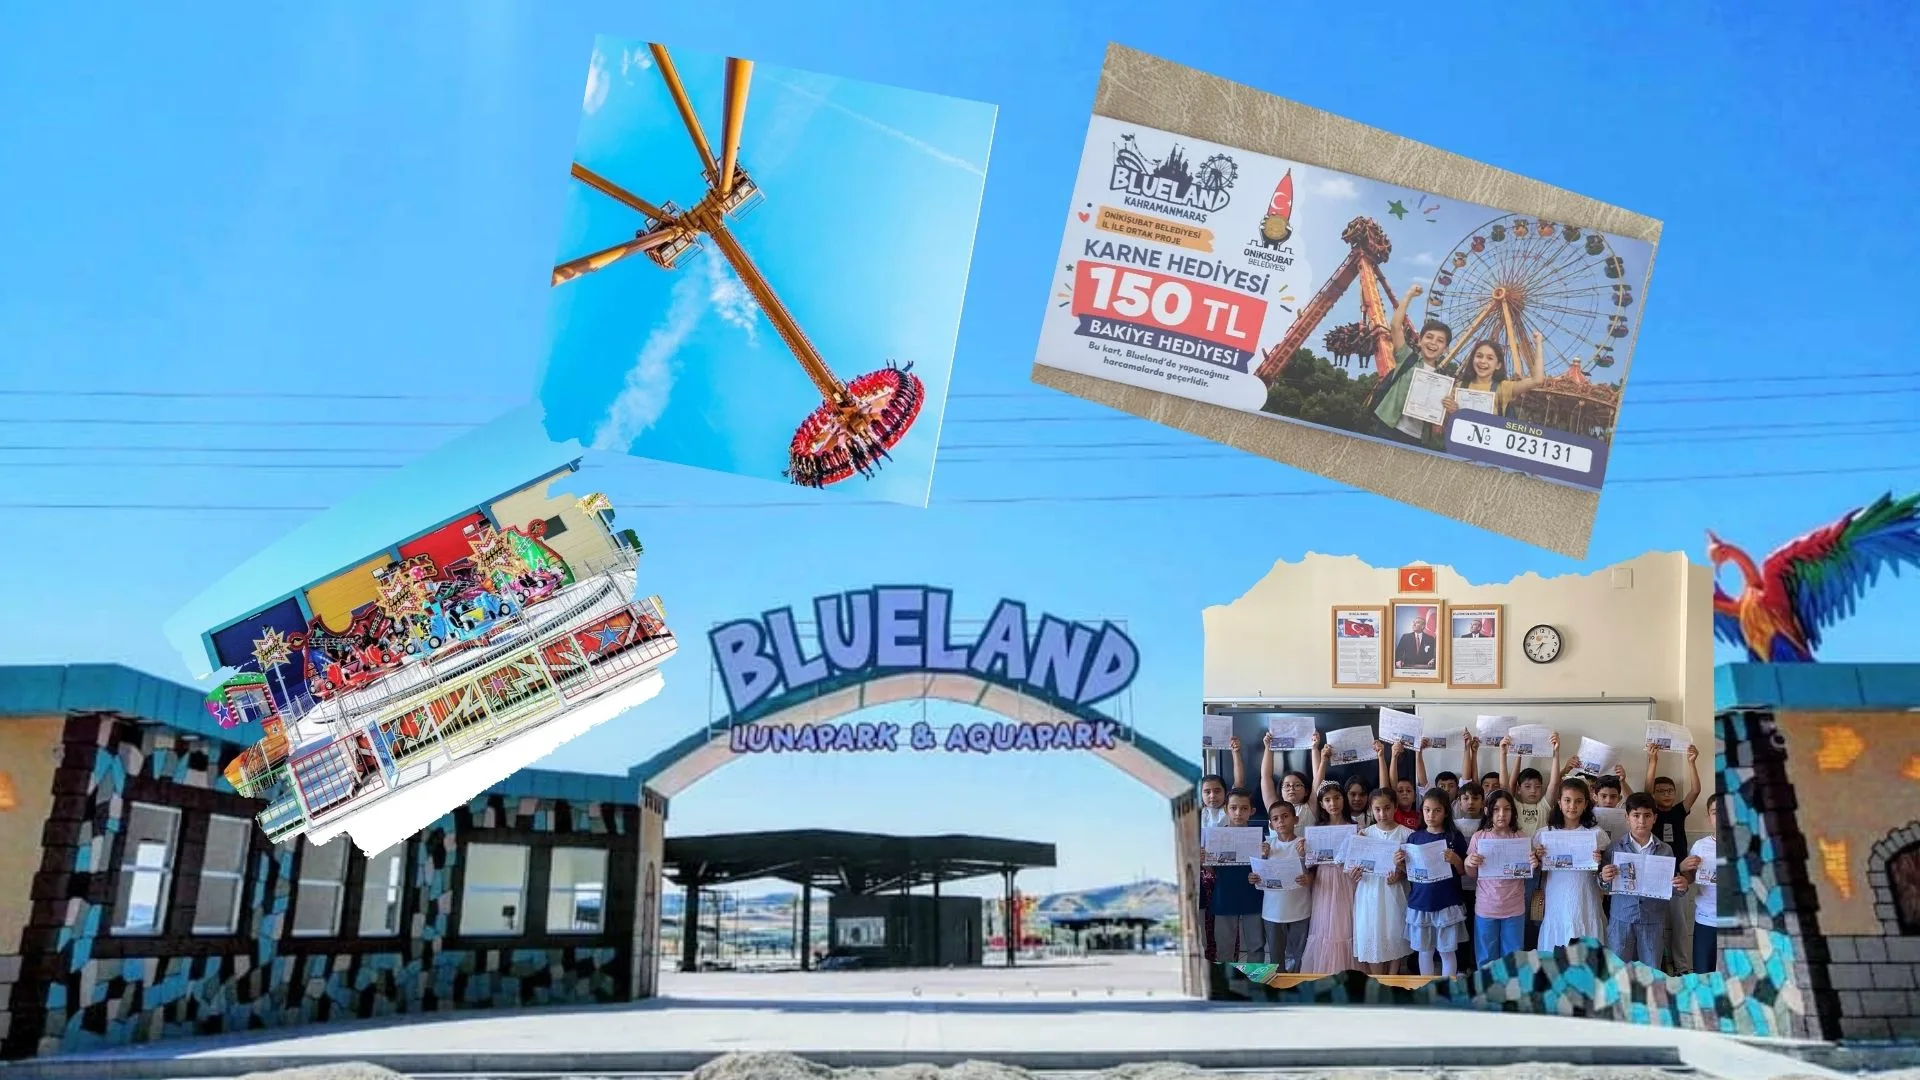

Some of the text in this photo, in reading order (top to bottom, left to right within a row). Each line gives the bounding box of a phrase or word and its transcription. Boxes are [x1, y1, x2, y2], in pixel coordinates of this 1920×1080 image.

[1109, 164, 1230, 213] BLUELAND
[1104, 211, 1202, 239] ONİKİŞUBAT BELEDİYESİ
[1124, 196, 1207, 223] KAHRAMANMARAŞ
[1111, 223, 1125, 232] İLE
[1126, 226, 1153, 239] ORTAK
[1154, 232, 1182, 245] PROJE
[1084, 238, 1271, 296] KARNE HEDİYESİ
[1090, 267, 1248, 339] 150 TL
[1089, 320, 1240, 366] BAKİYE HEDİYESİ
[1088, 341, 1101, 351] Bu
[1102, 344, 1122, 357] kart,
[1178, 363, 1230, 381] yapacağınız
[1103, 356, 1209, 388] harcamalarda geçerlidir.
[1528, 427, 1543, 436] NO
[1505, 433, 1571, 463] 023131
[708, 584, 1139, 713] BLUELAND
[729, 722, 1116, 753] LUNAPARK & AQUAPARK
